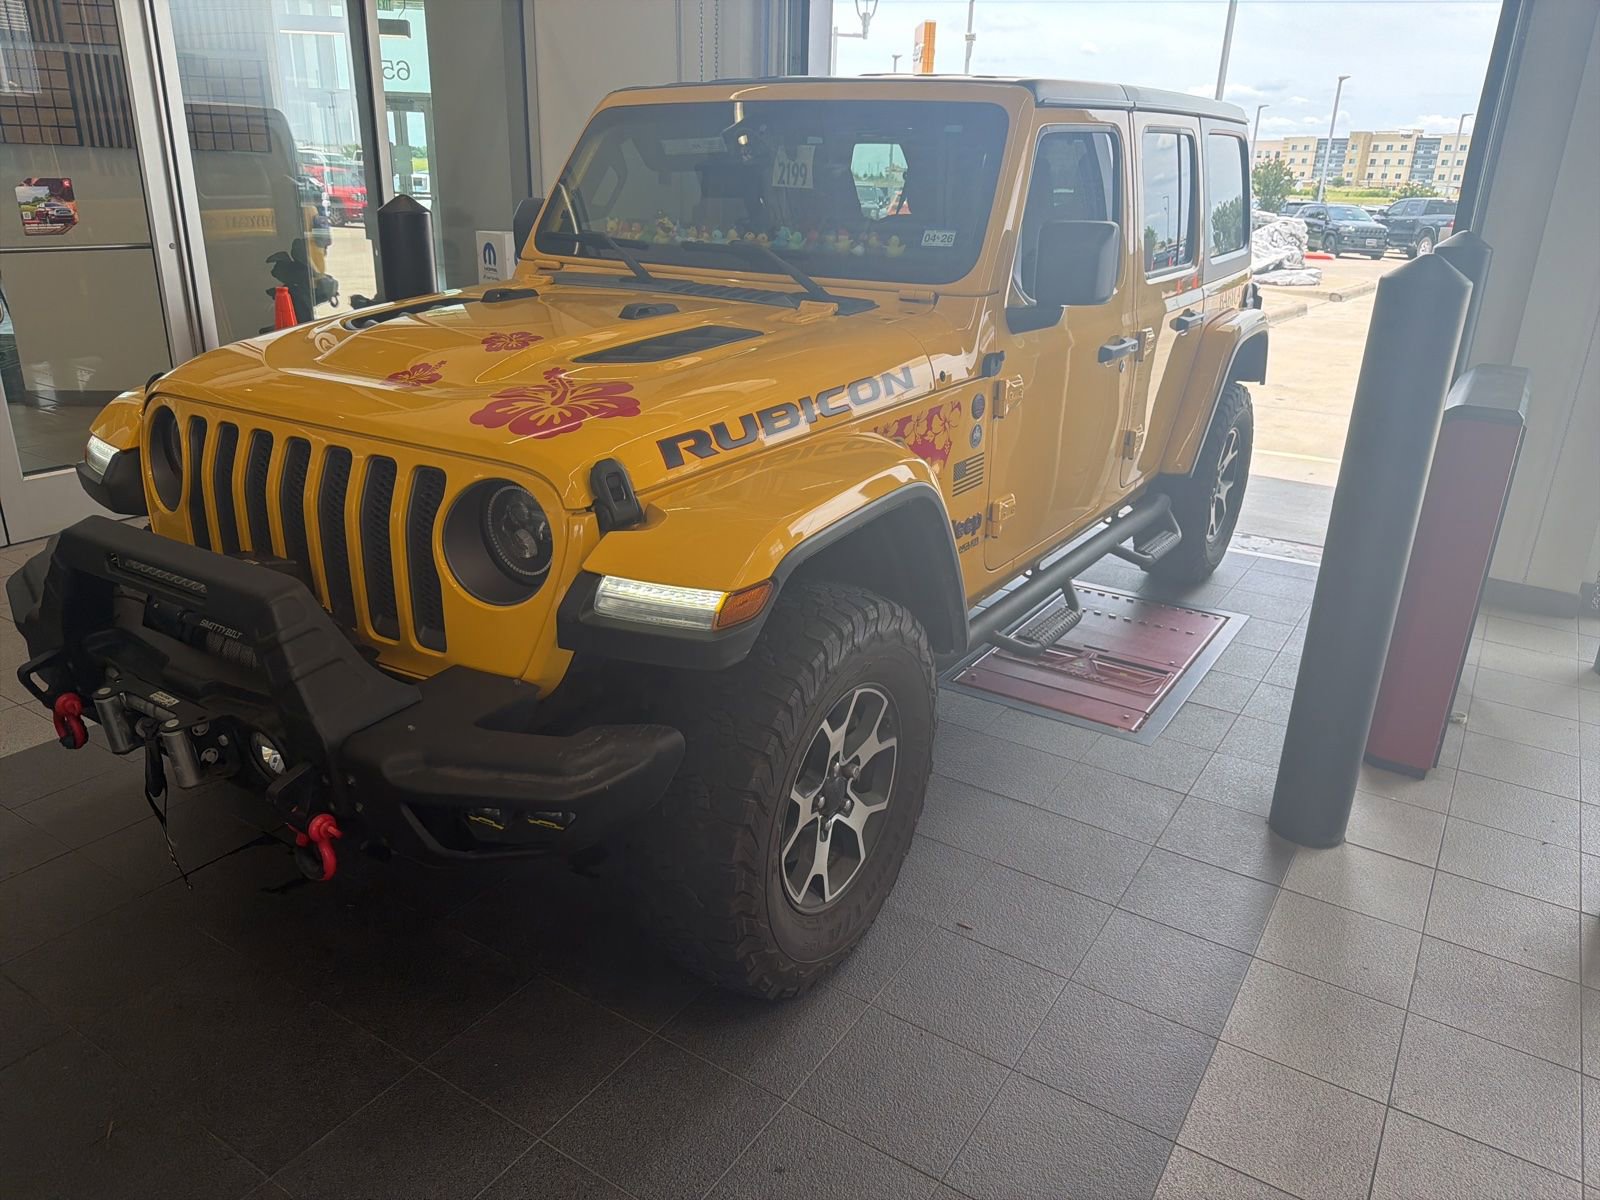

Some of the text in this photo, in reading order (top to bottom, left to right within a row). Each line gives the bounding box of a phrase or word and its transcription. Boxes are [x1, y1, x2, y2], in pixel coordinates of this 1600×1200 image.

[778, 160, 807, 186] 2199
[940, 233, 954, 243] 26
[656, 366, 915, 470] RUBICON
